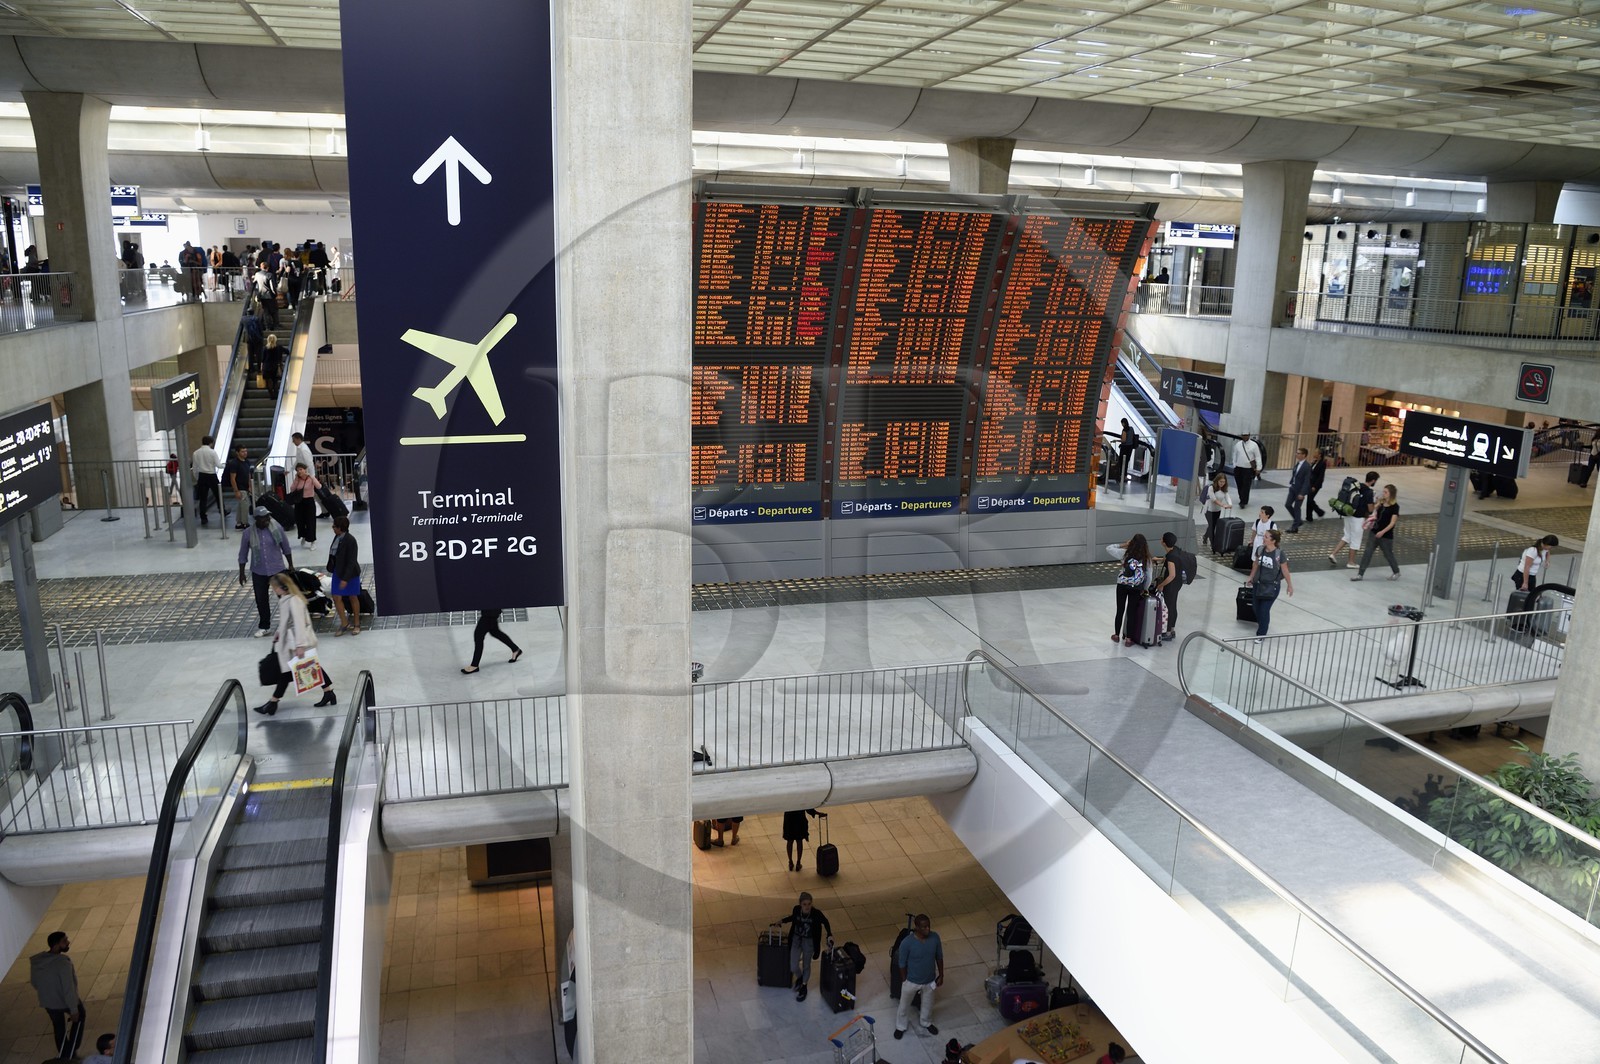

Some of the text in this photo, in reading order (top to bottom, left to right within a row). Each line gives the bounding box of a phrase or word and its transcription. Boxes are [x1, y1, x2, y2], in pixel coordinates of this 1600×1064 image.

[1194, 382, 1204, 390] Paris
[1186, 390, 1201, 398] Grandes
[1442, 428, 1461, 439] Paris
[418, 488, 514, 509] Terminal
[991, 498, 1025, 508] Départs
[1033, 496, 1080, 506] Departures
[709, 508, 748, 519] Départs
[758, 506, 812, 516] Departures
[855, 503, 892, 513] Départs
[901, 501, 952, 511] Departures
[412, 512, 523, 526] Terminal Terminale
[398, 536, 537, 562] 2B 2D 2F 2G
